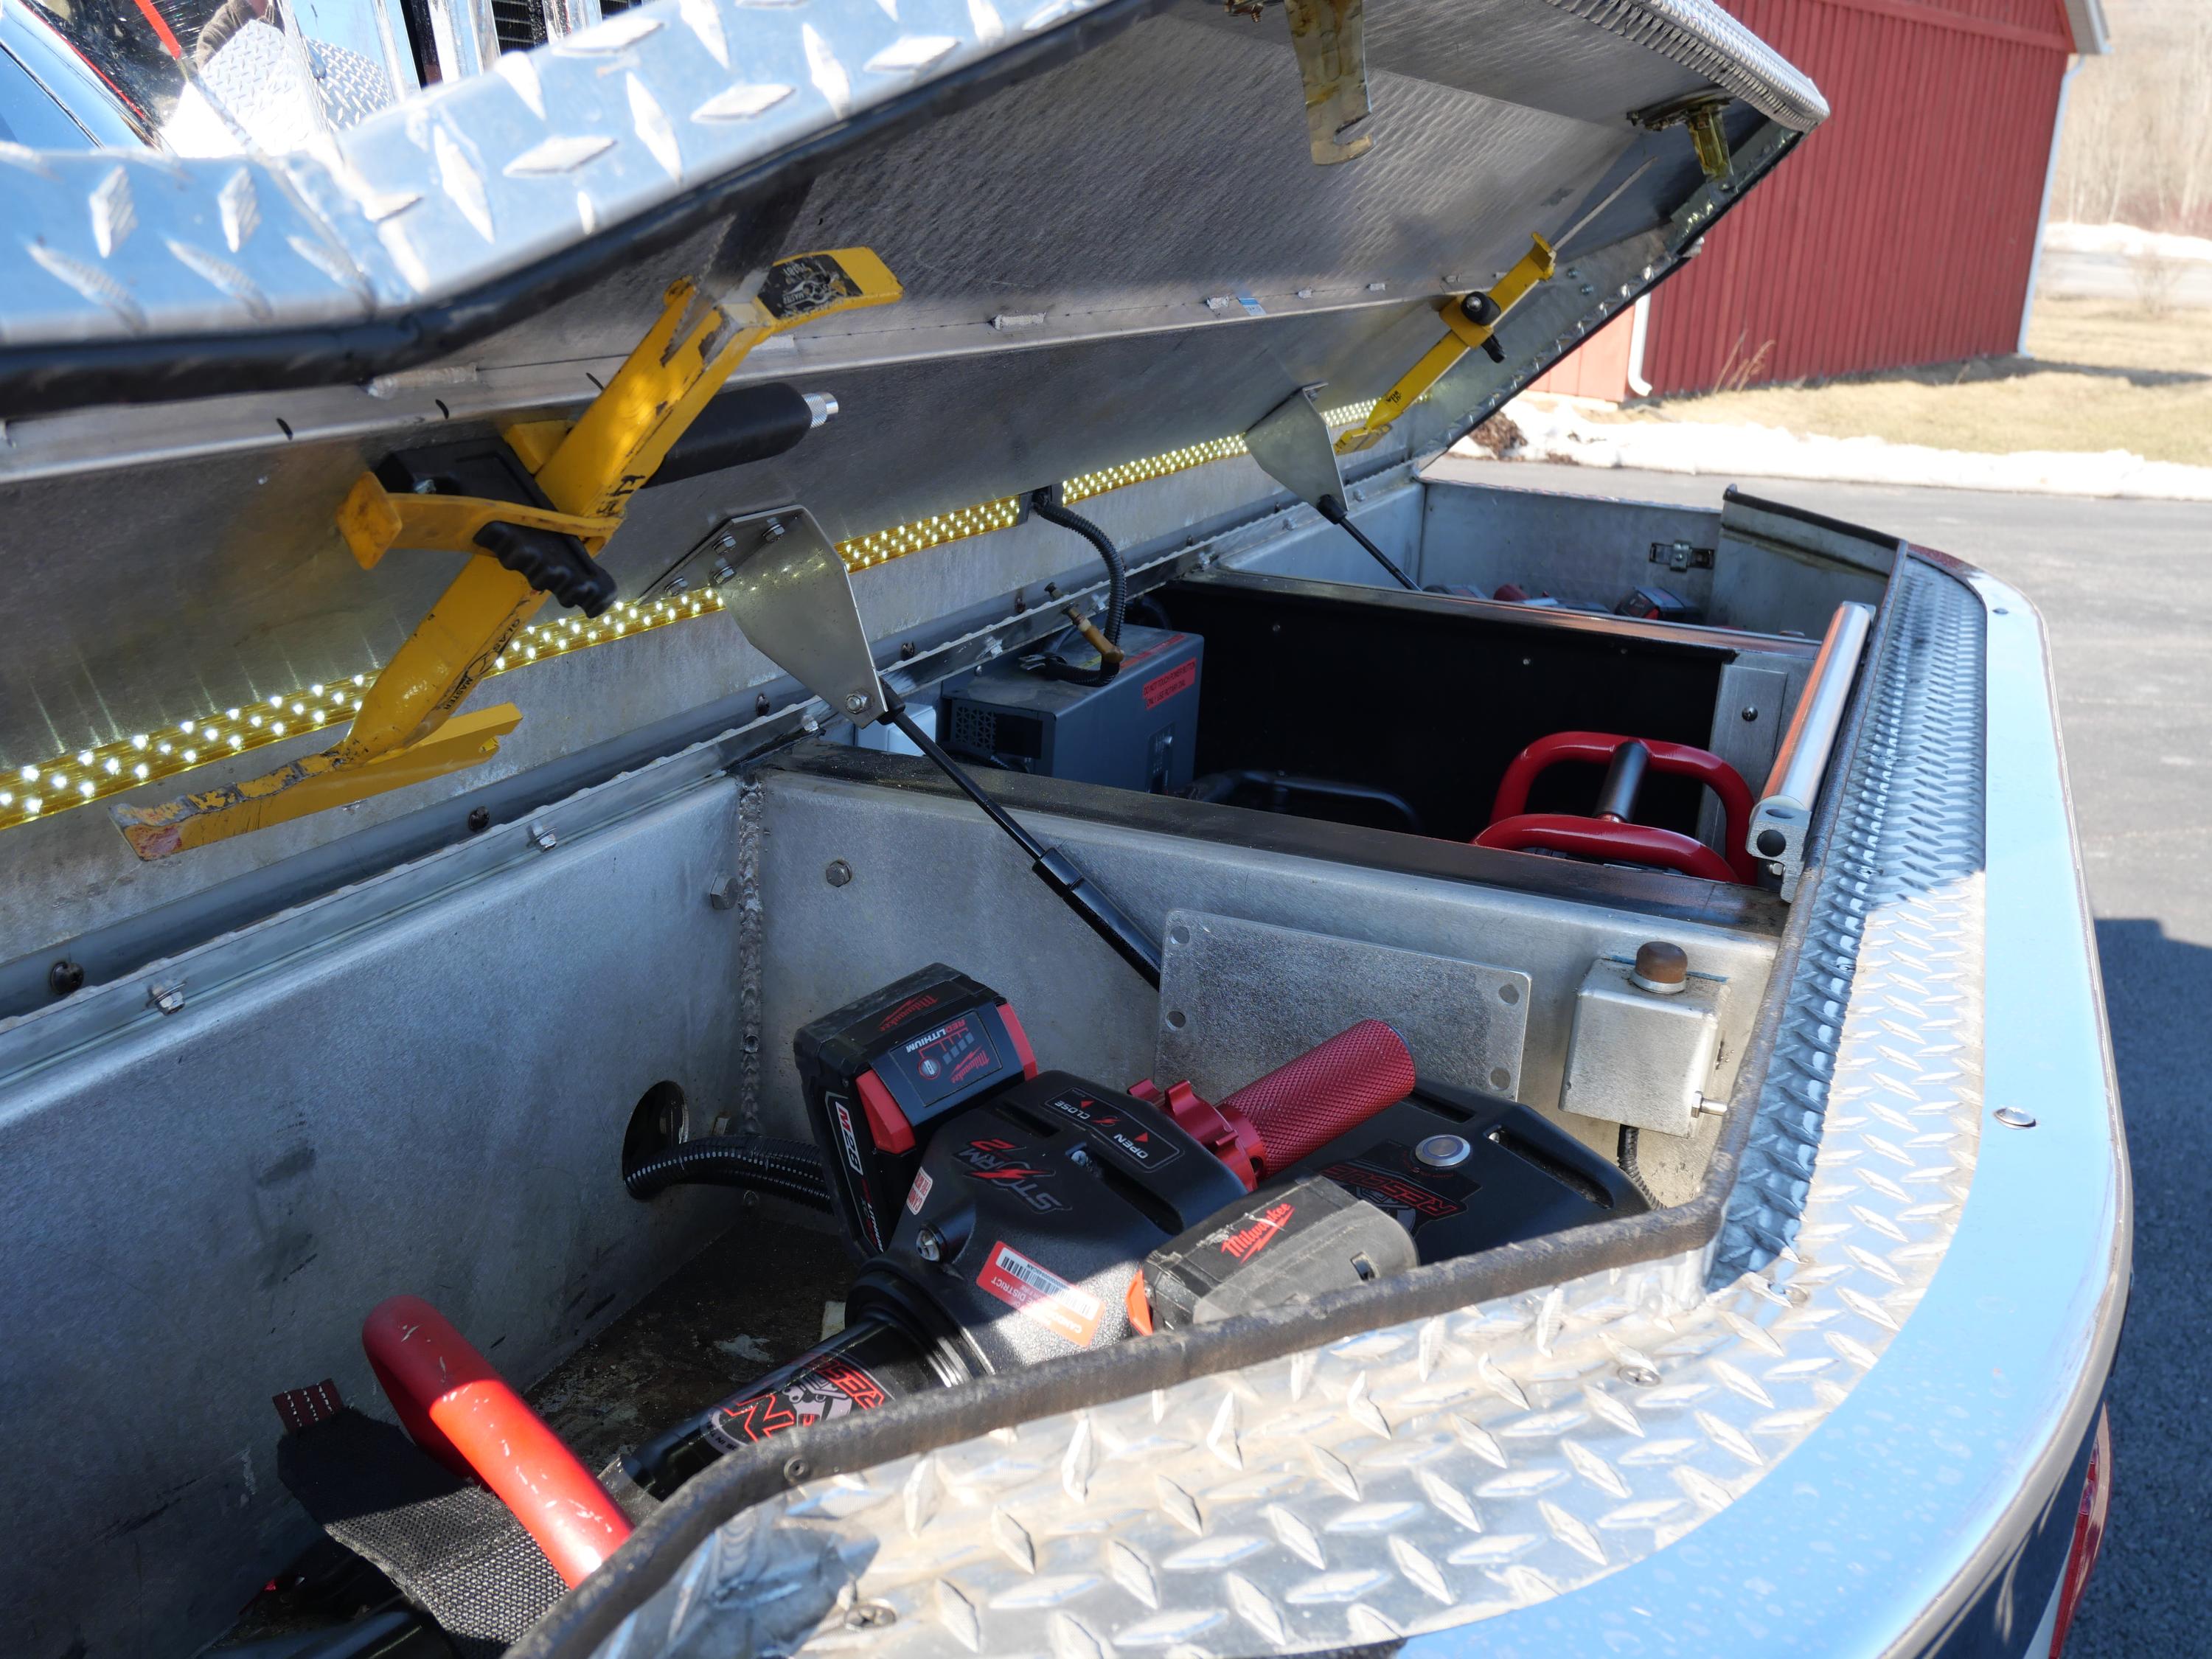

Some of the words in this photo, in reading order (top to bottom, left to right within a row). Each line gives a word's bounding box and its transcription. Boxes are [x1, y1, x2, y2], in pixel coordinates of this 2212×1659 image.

[880, 995, 937, 1031] Milwaukee
[905, 1018, 966, 1052] REDLITHIUM
[950, 1050, 990, 1083] Milwaukee
[1054, 1099, 1091, 1119] CLOSE
[837, 1104, 863, 1175] M28
[1113, 1133, 1150, 1159] OPEN
[958, 1145, 1062, 1211] STORM
[1220, 1202, 1295, 1262] Milwaukee
[990, 1276, 1027, 1301] DISTRICT
